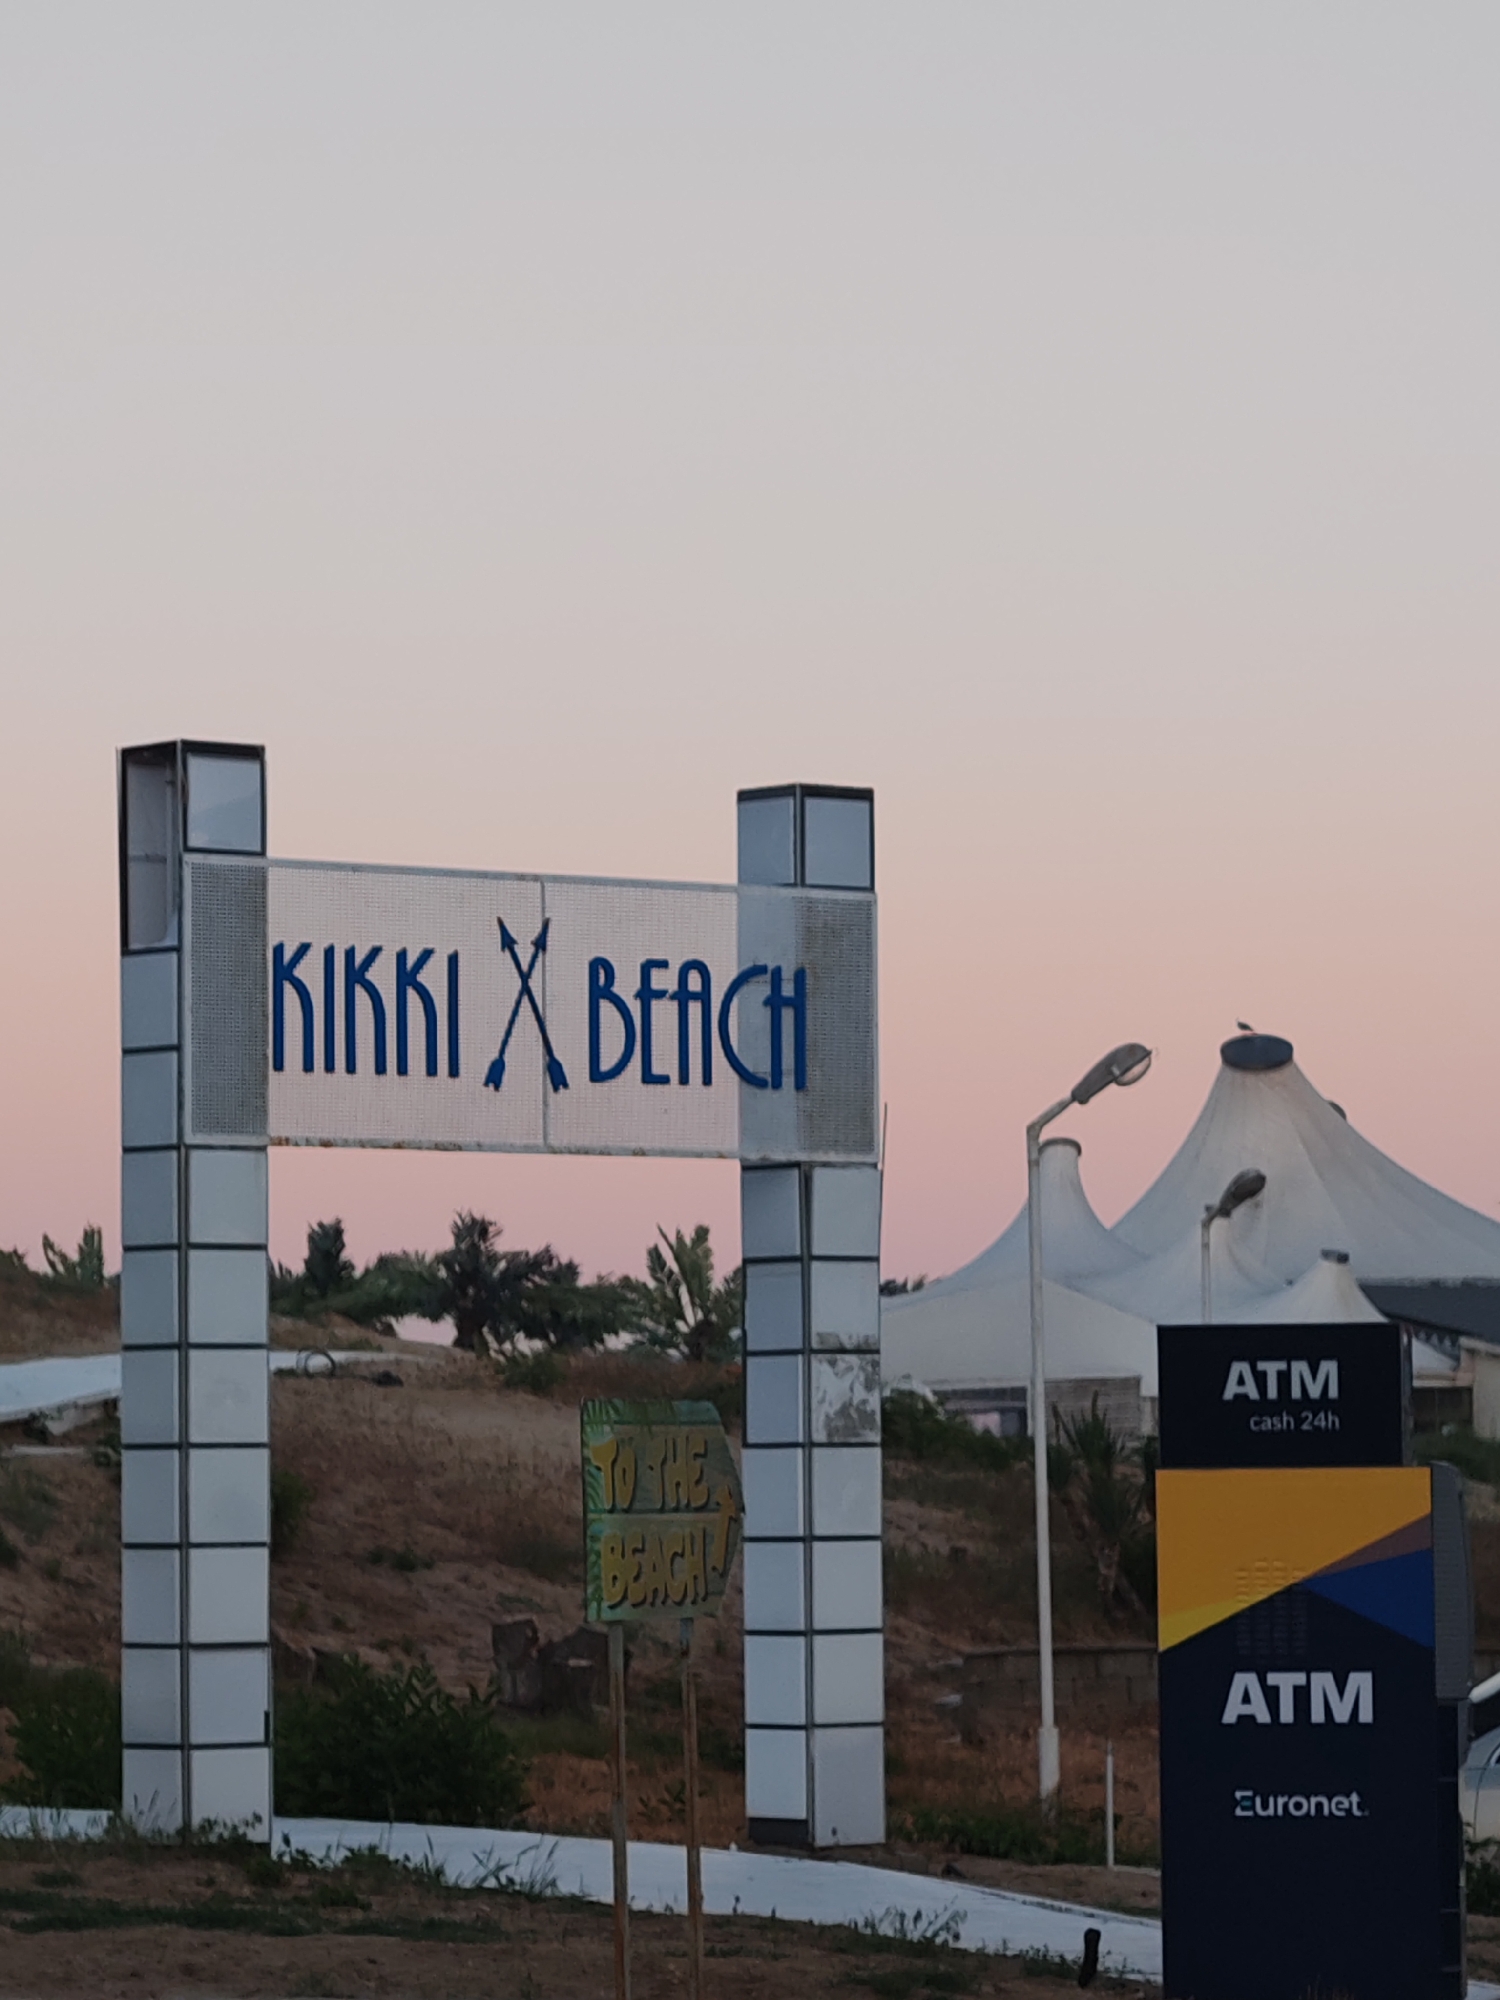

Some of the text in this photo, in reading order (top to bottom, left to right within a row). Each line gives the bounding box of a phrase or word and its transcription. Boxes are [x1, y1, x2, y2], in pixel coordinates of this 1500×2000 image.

[272, 941, 808, 1091] KIKKI BEACH
[1222, 1359, 1340, 1401] ATM
[1249, 1410, 1341, 1432] cash 24h
[590, 1434, 710, 1512] TO THE
[602, 1526, 707, 1609] BEACH
[1221, 1671, 1375, 1725] ATM
[1234, 1790, 1364, 1818] Euronet
